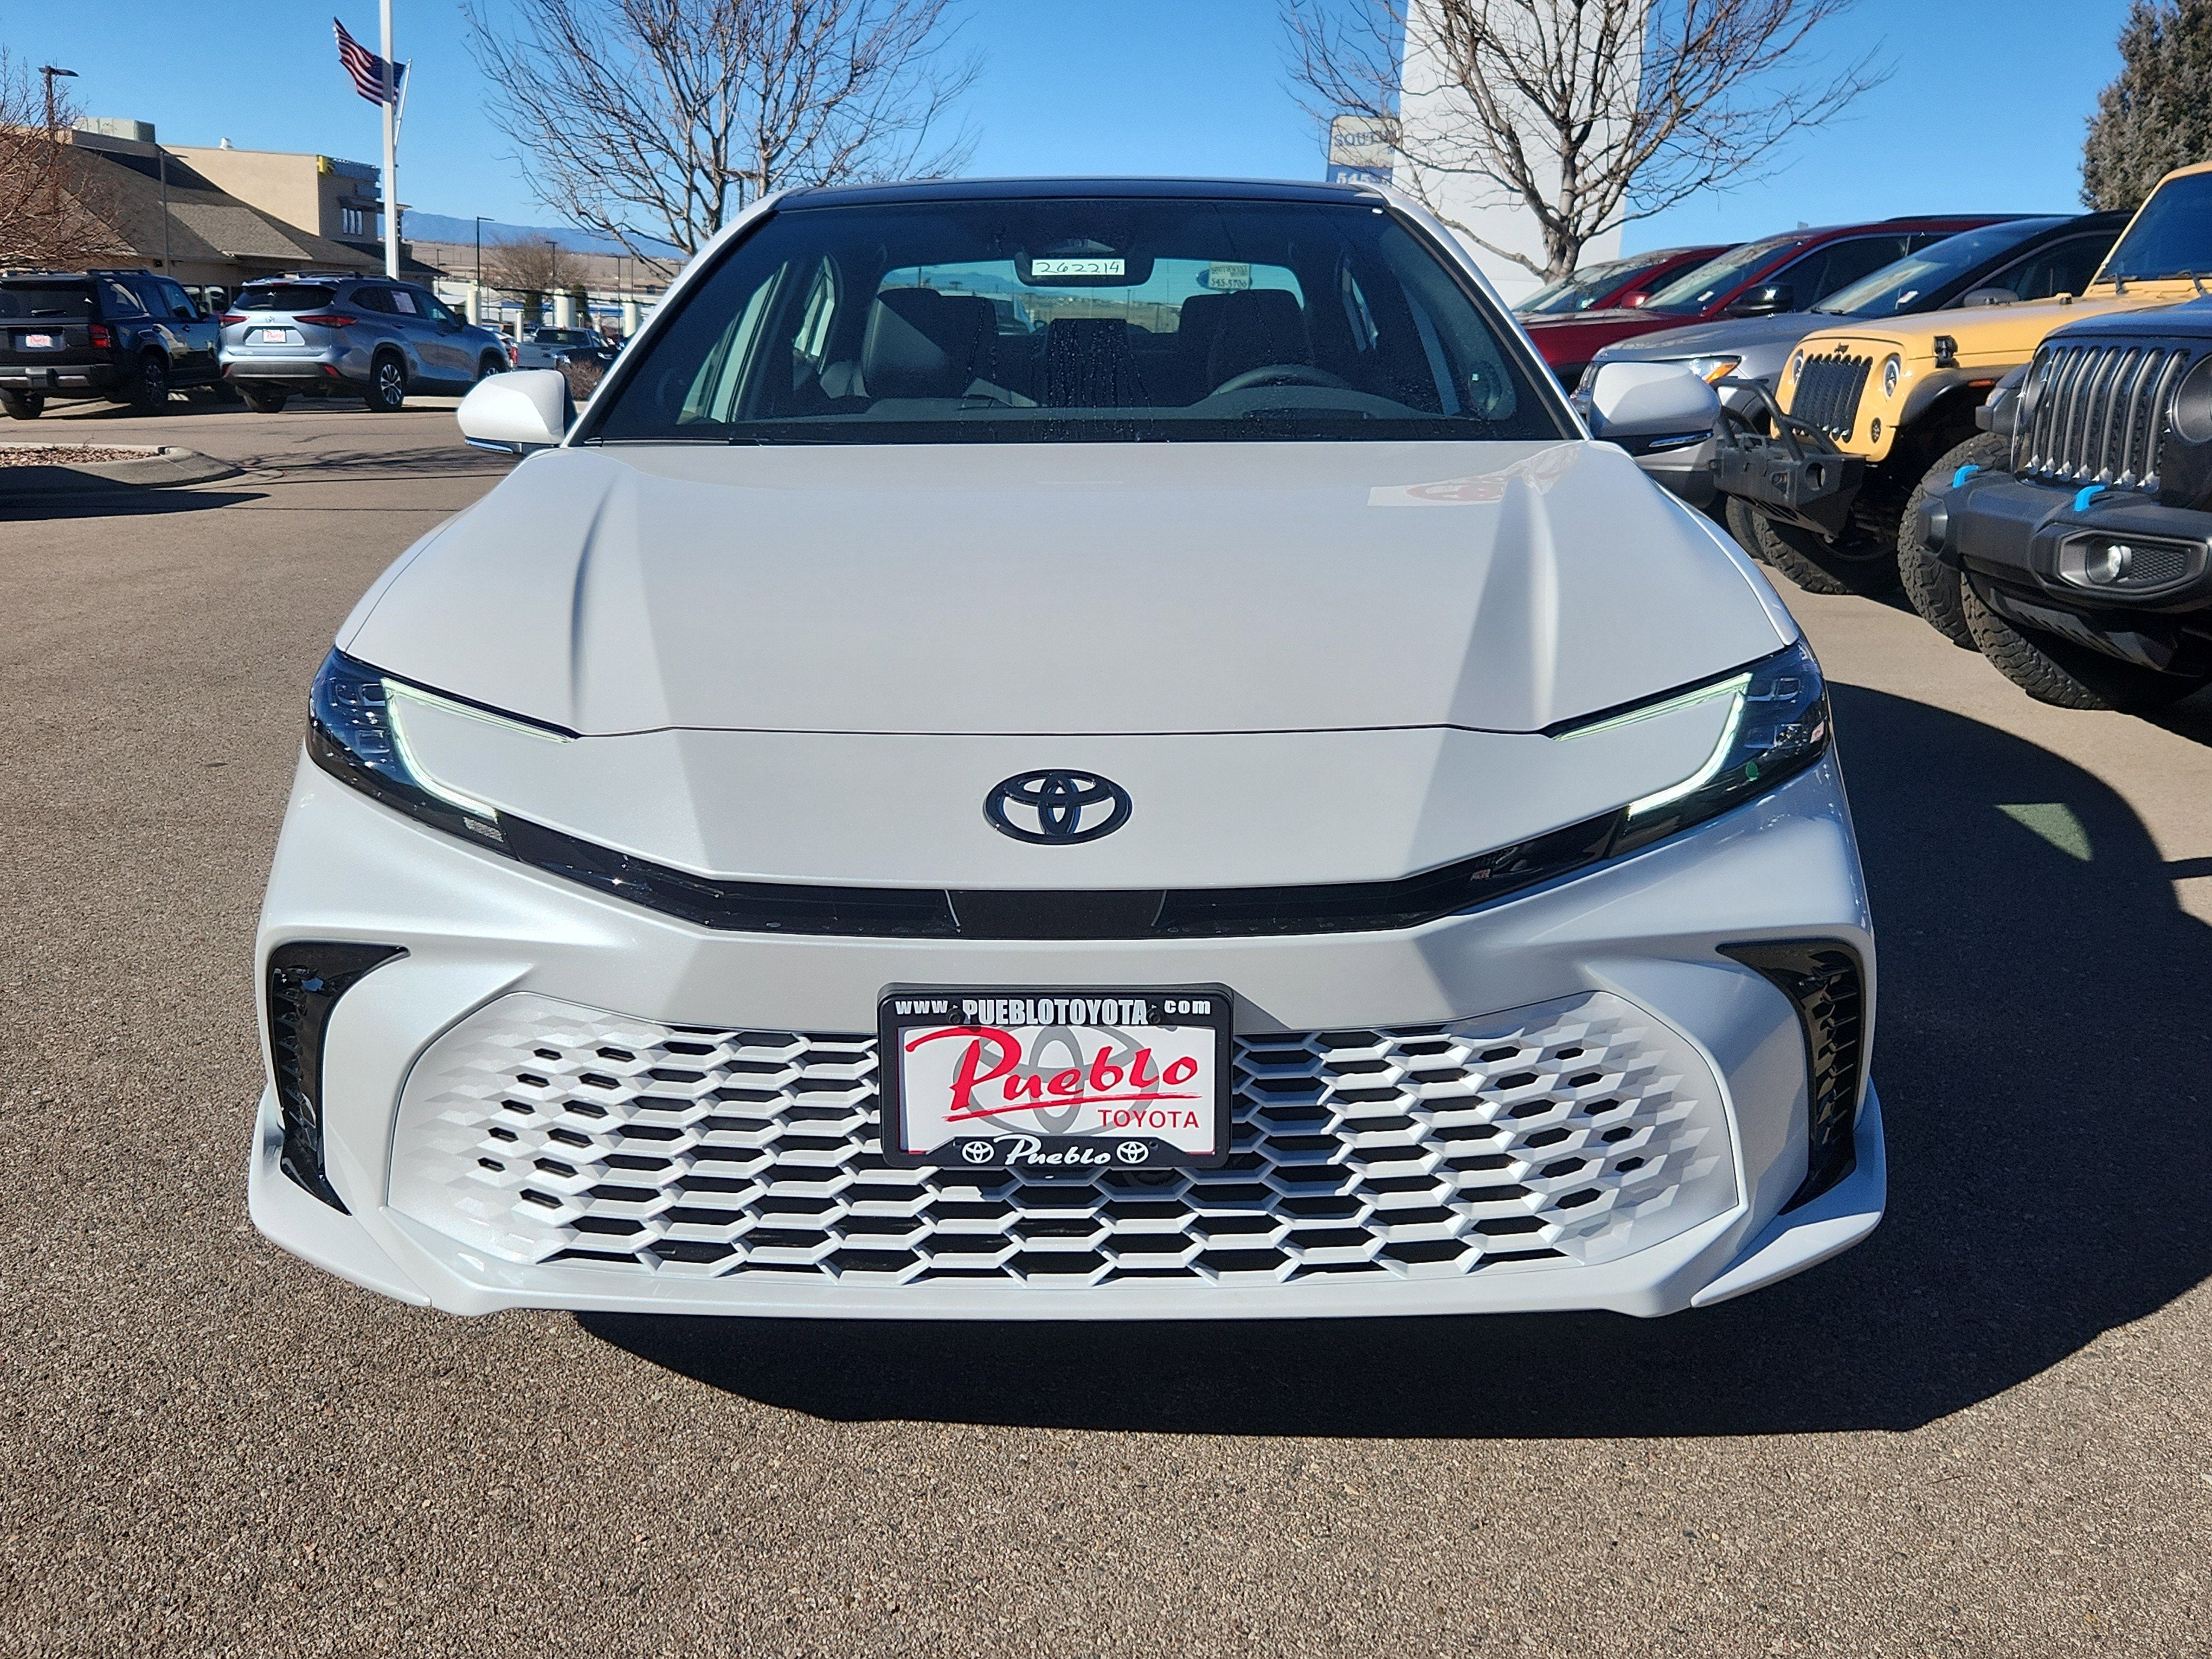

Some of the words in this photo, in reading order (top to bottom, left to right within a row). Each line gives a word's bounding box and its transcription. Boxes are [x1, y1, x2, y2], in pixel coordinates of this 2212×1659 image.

[1036, 261, 1119, 274] 262214
[962, 999, 1148, 1025] PUEBLOTOYOTA
[1164, 1000, 1211, 1014] com
[905, 1026, 1198, 1111] Pueblo
[1098, 1109, 1199, 1129] TOYOTA
[993, 1134, 1111, 1166] Pueblo
